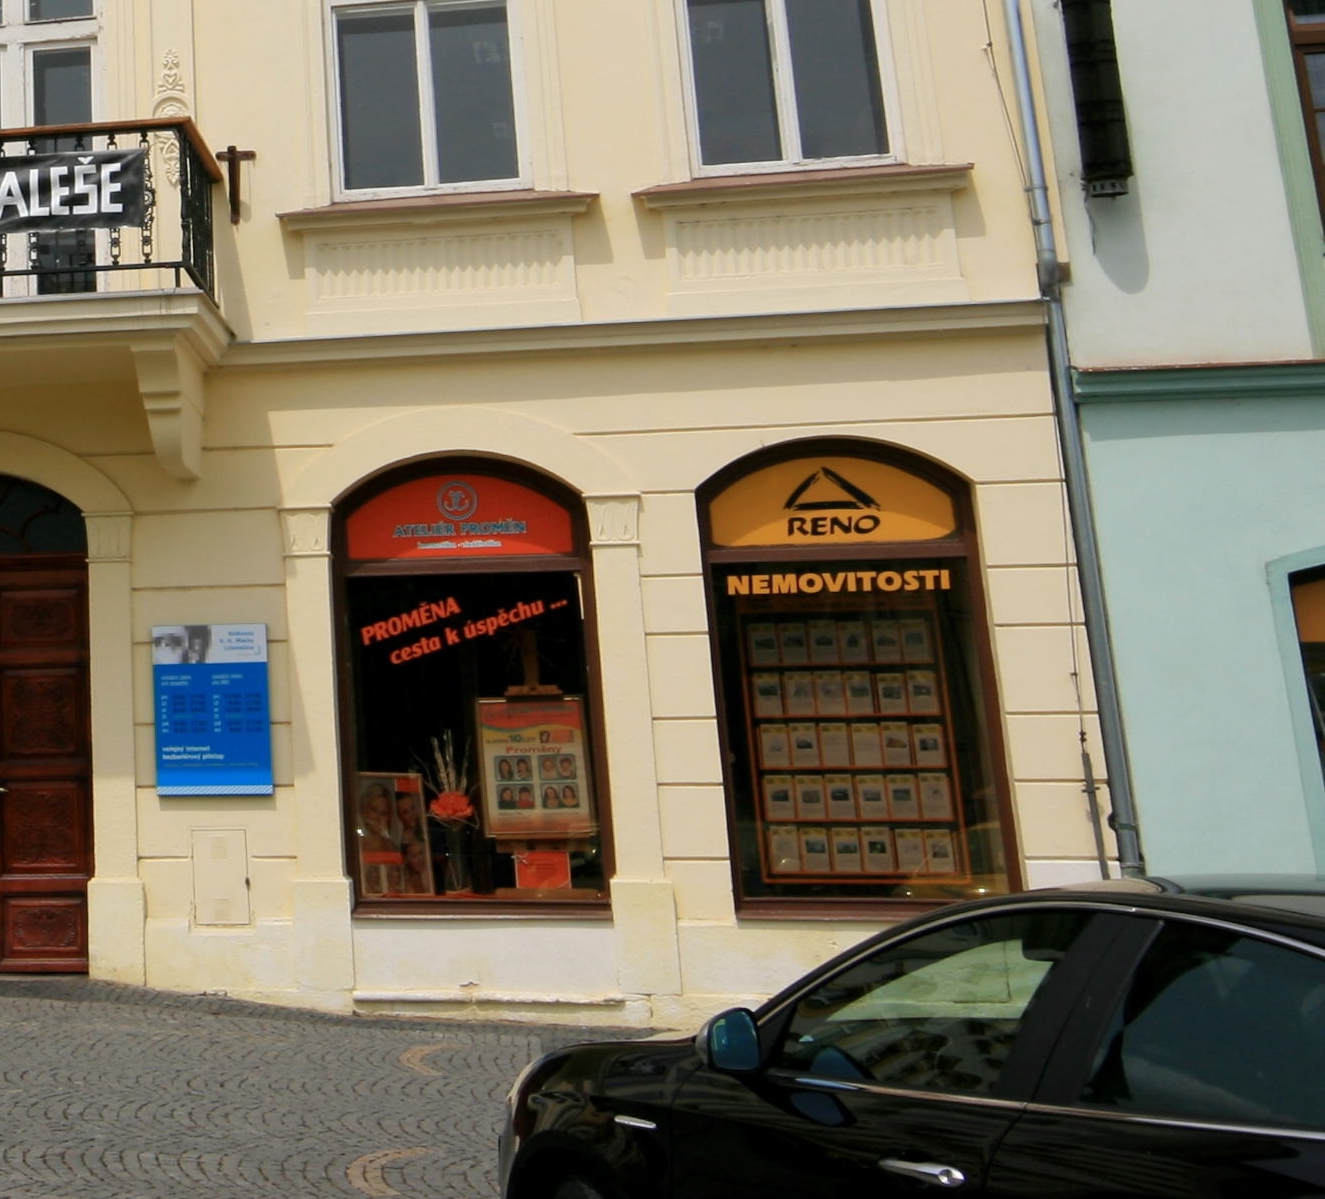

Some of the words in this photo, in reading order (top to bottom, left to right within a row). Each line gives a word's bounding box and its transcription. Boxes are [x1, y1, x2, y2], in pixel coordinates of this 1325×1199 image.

[393, 521, 456, 537] ATELIÉR
[460, 518, 527, 535] PROMĚN
[787, 515, 881, 536] RENO
[727, 569, 951, 596] NEMOVITOSTI
[360, 597, 462, 645] PROMĚNA
[390, 637, 442, 664] cesta
[445, 627, 460, 645] k
[464, 600, 545, 639] úspěchu
